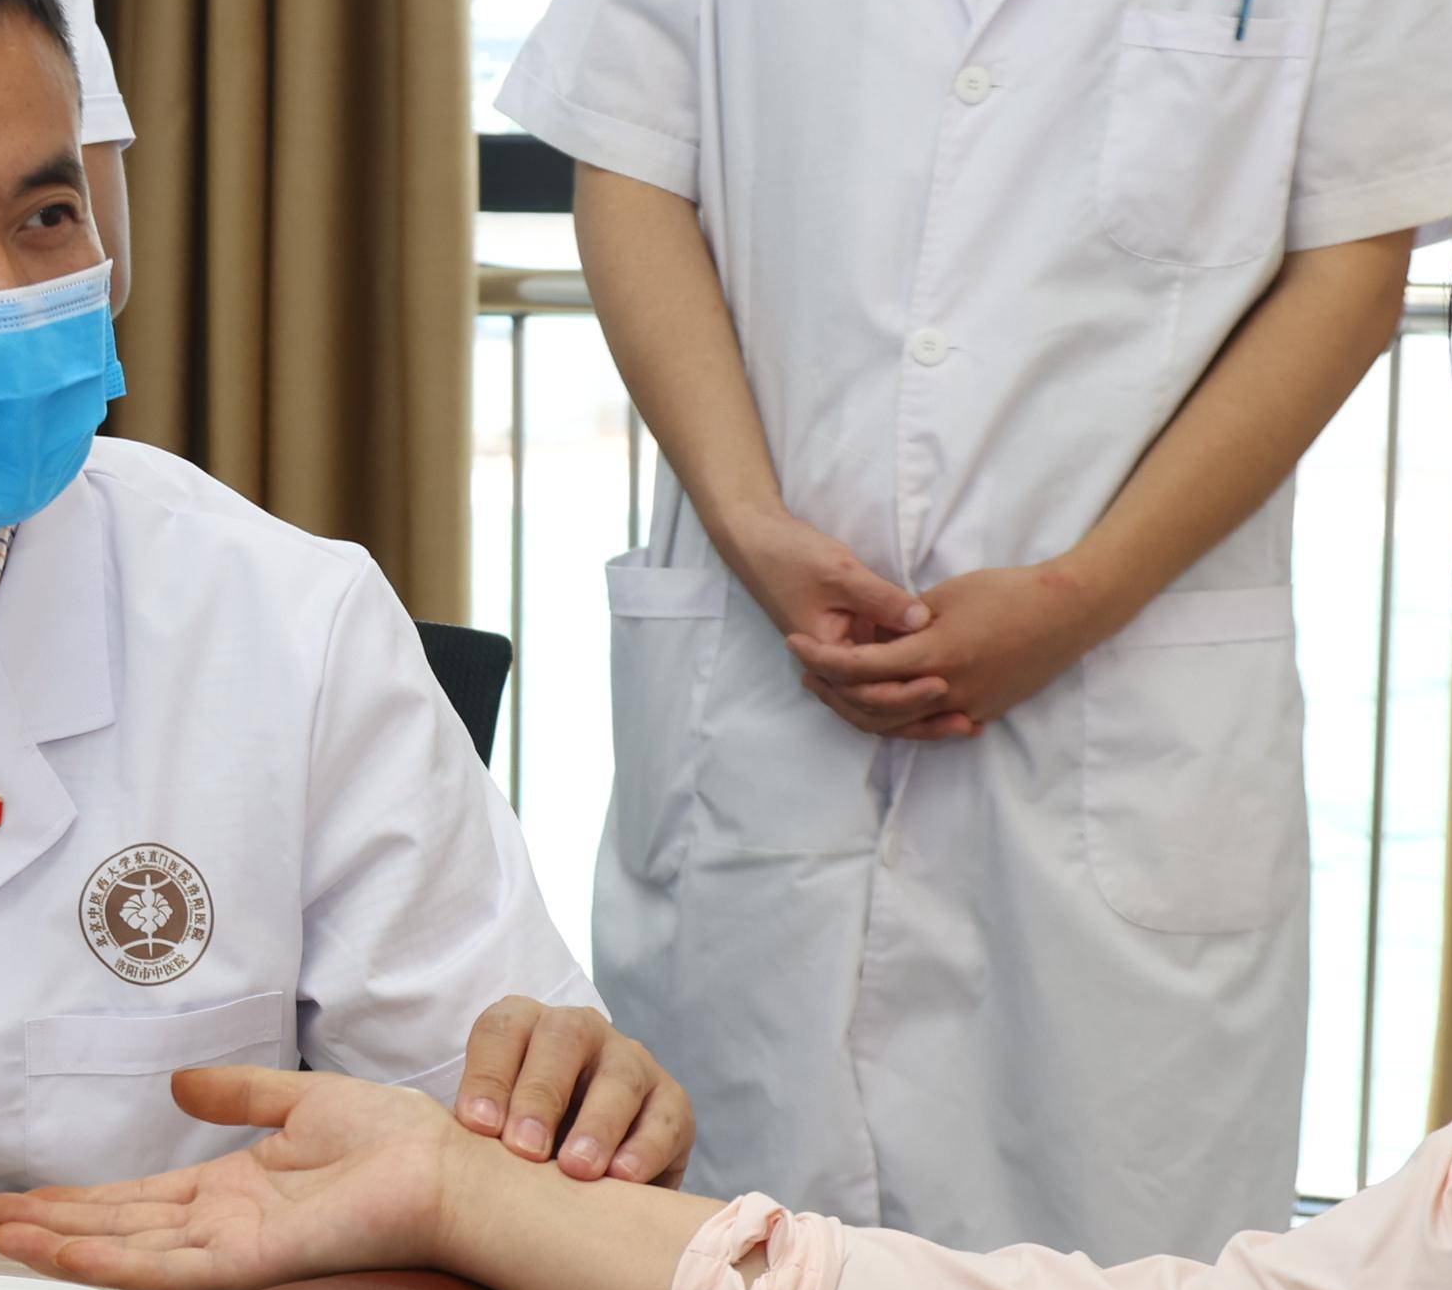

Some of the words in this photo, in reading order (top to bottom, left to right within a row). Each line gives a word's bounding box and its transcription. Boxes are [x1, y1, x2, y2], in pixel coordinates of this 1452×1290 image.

[87, 850, 206, 947] 北京中医药大学东直门医院洛阳医院
[115, 954, 189, 980] 洛阳市中医院
